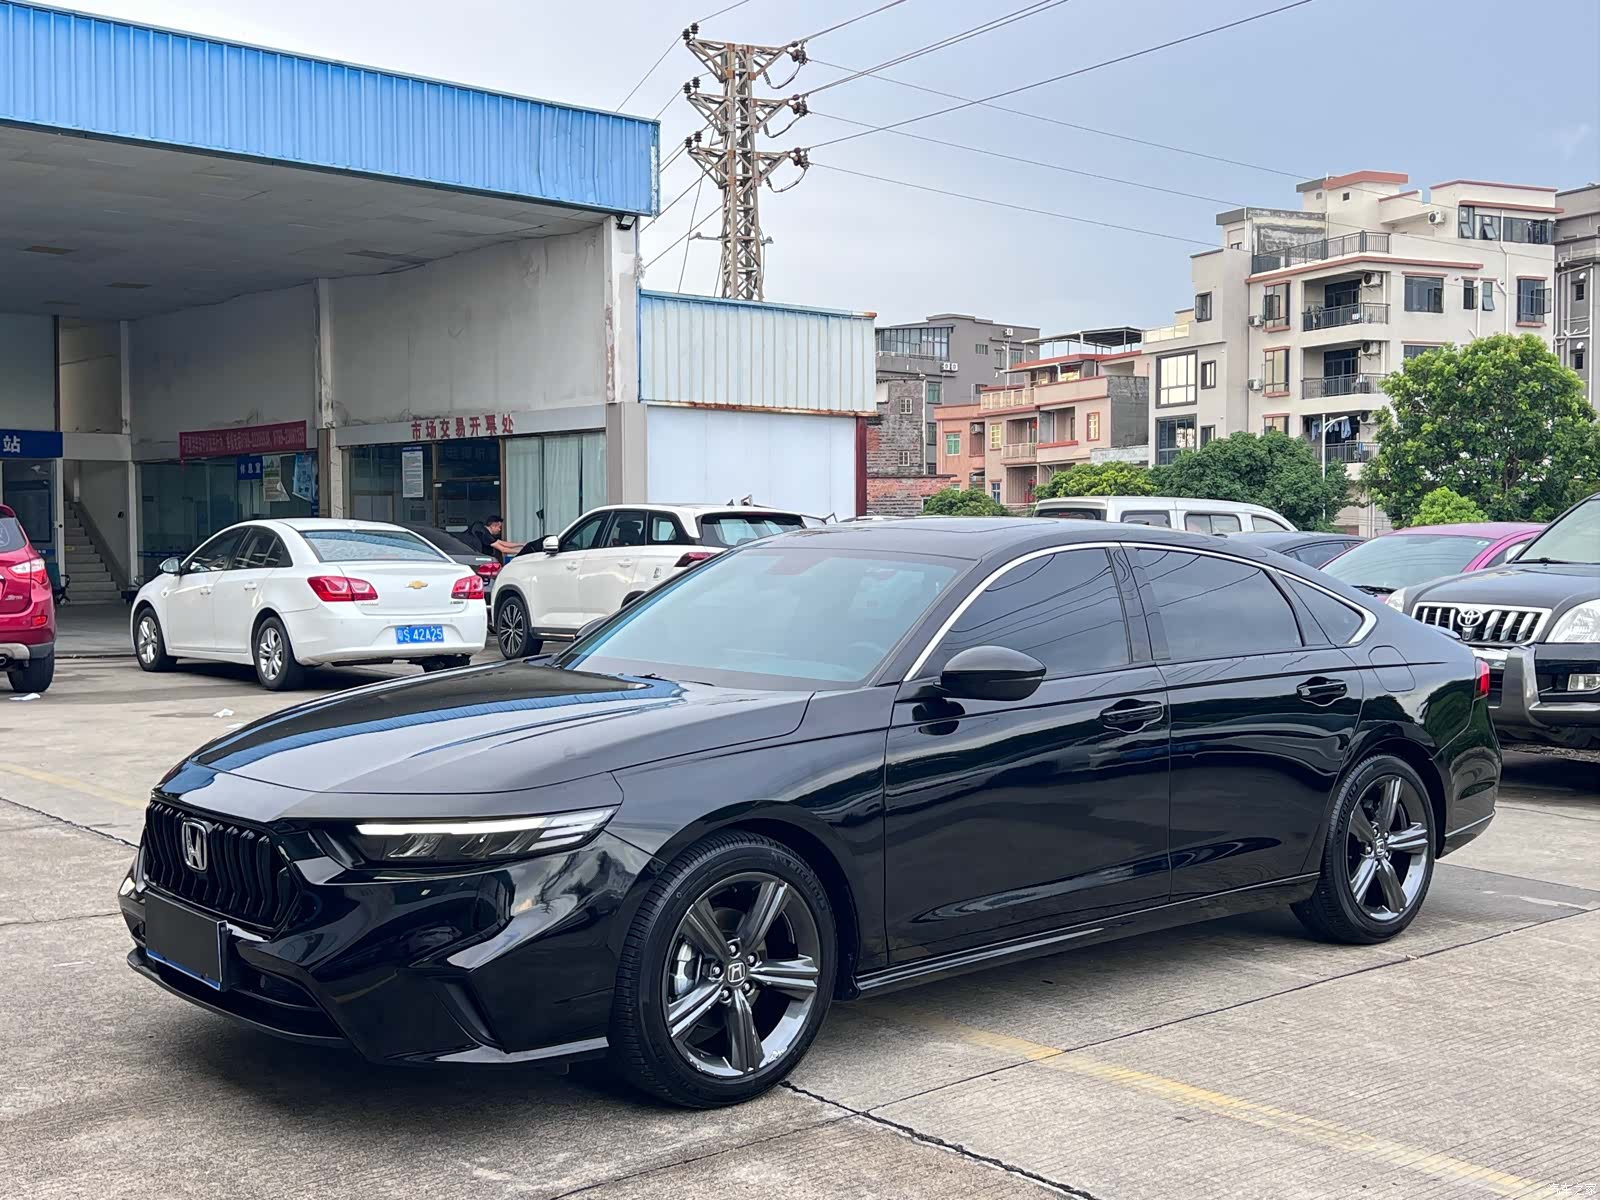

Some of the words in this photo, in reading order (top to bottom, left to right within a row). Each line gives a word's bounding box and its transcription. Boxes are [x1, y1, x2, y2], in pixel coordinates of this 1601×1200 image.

[411, 413, 514, 441] 市场交易开票处
[3, 435, 21, 453] 站
